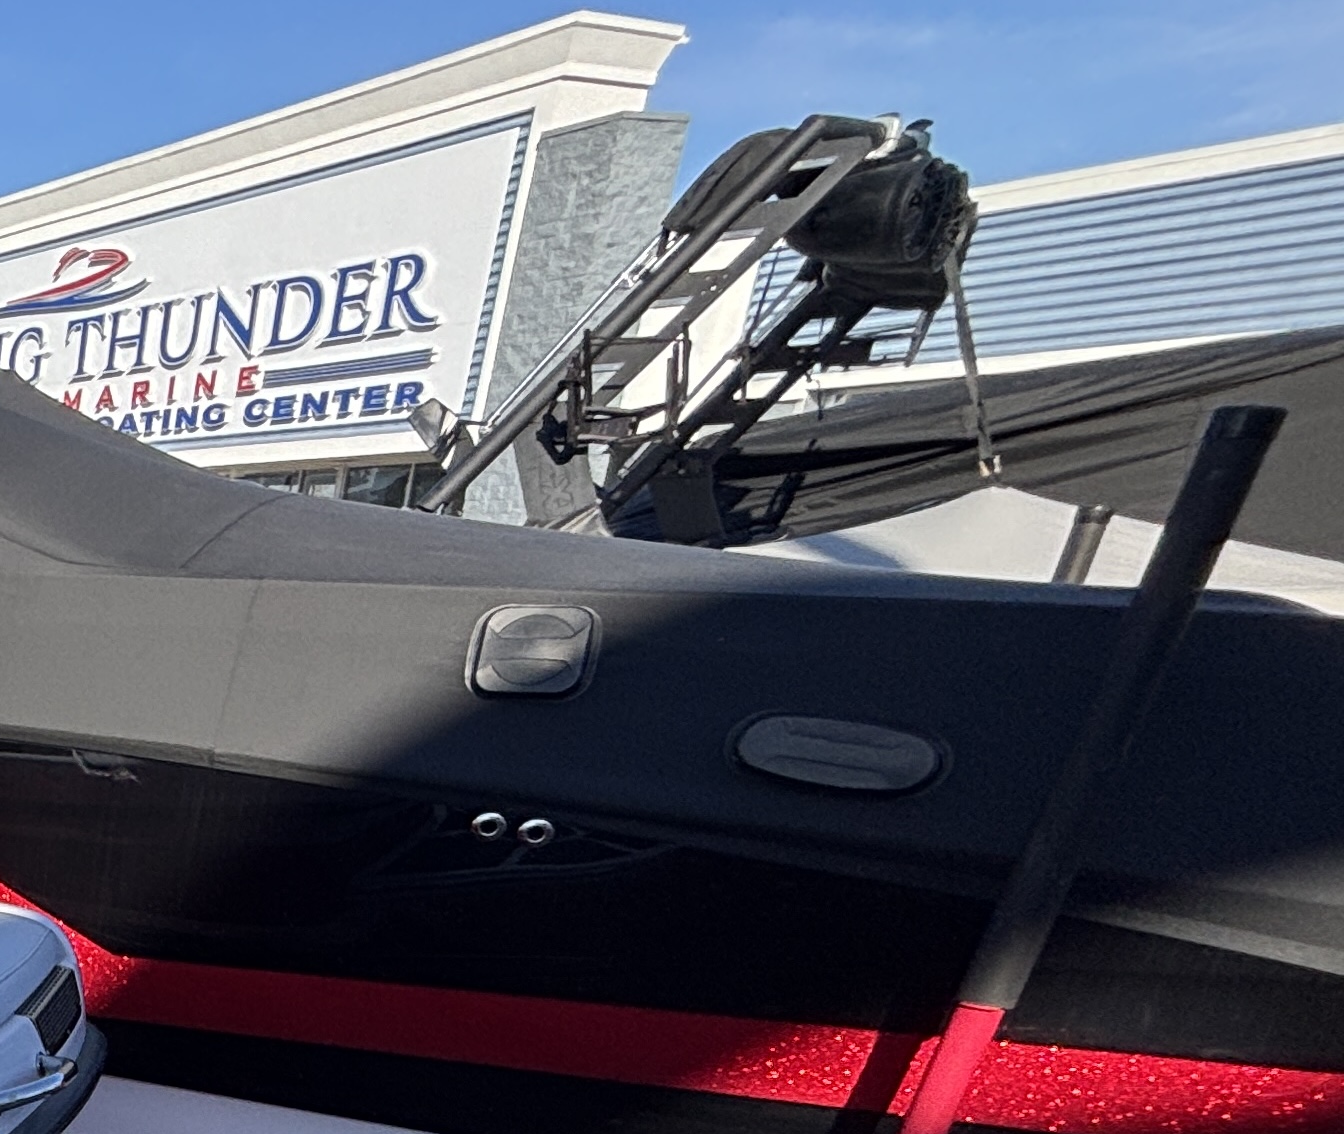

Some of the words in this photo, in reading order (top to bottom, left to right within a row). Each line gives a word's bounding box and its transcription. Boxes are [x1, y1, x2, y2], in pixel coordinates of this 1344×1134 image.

[65, 252, 438, 384] THUNDER
[63, 365, 260, 414] MARINE
[243, 381, 425, 428] CENTER
